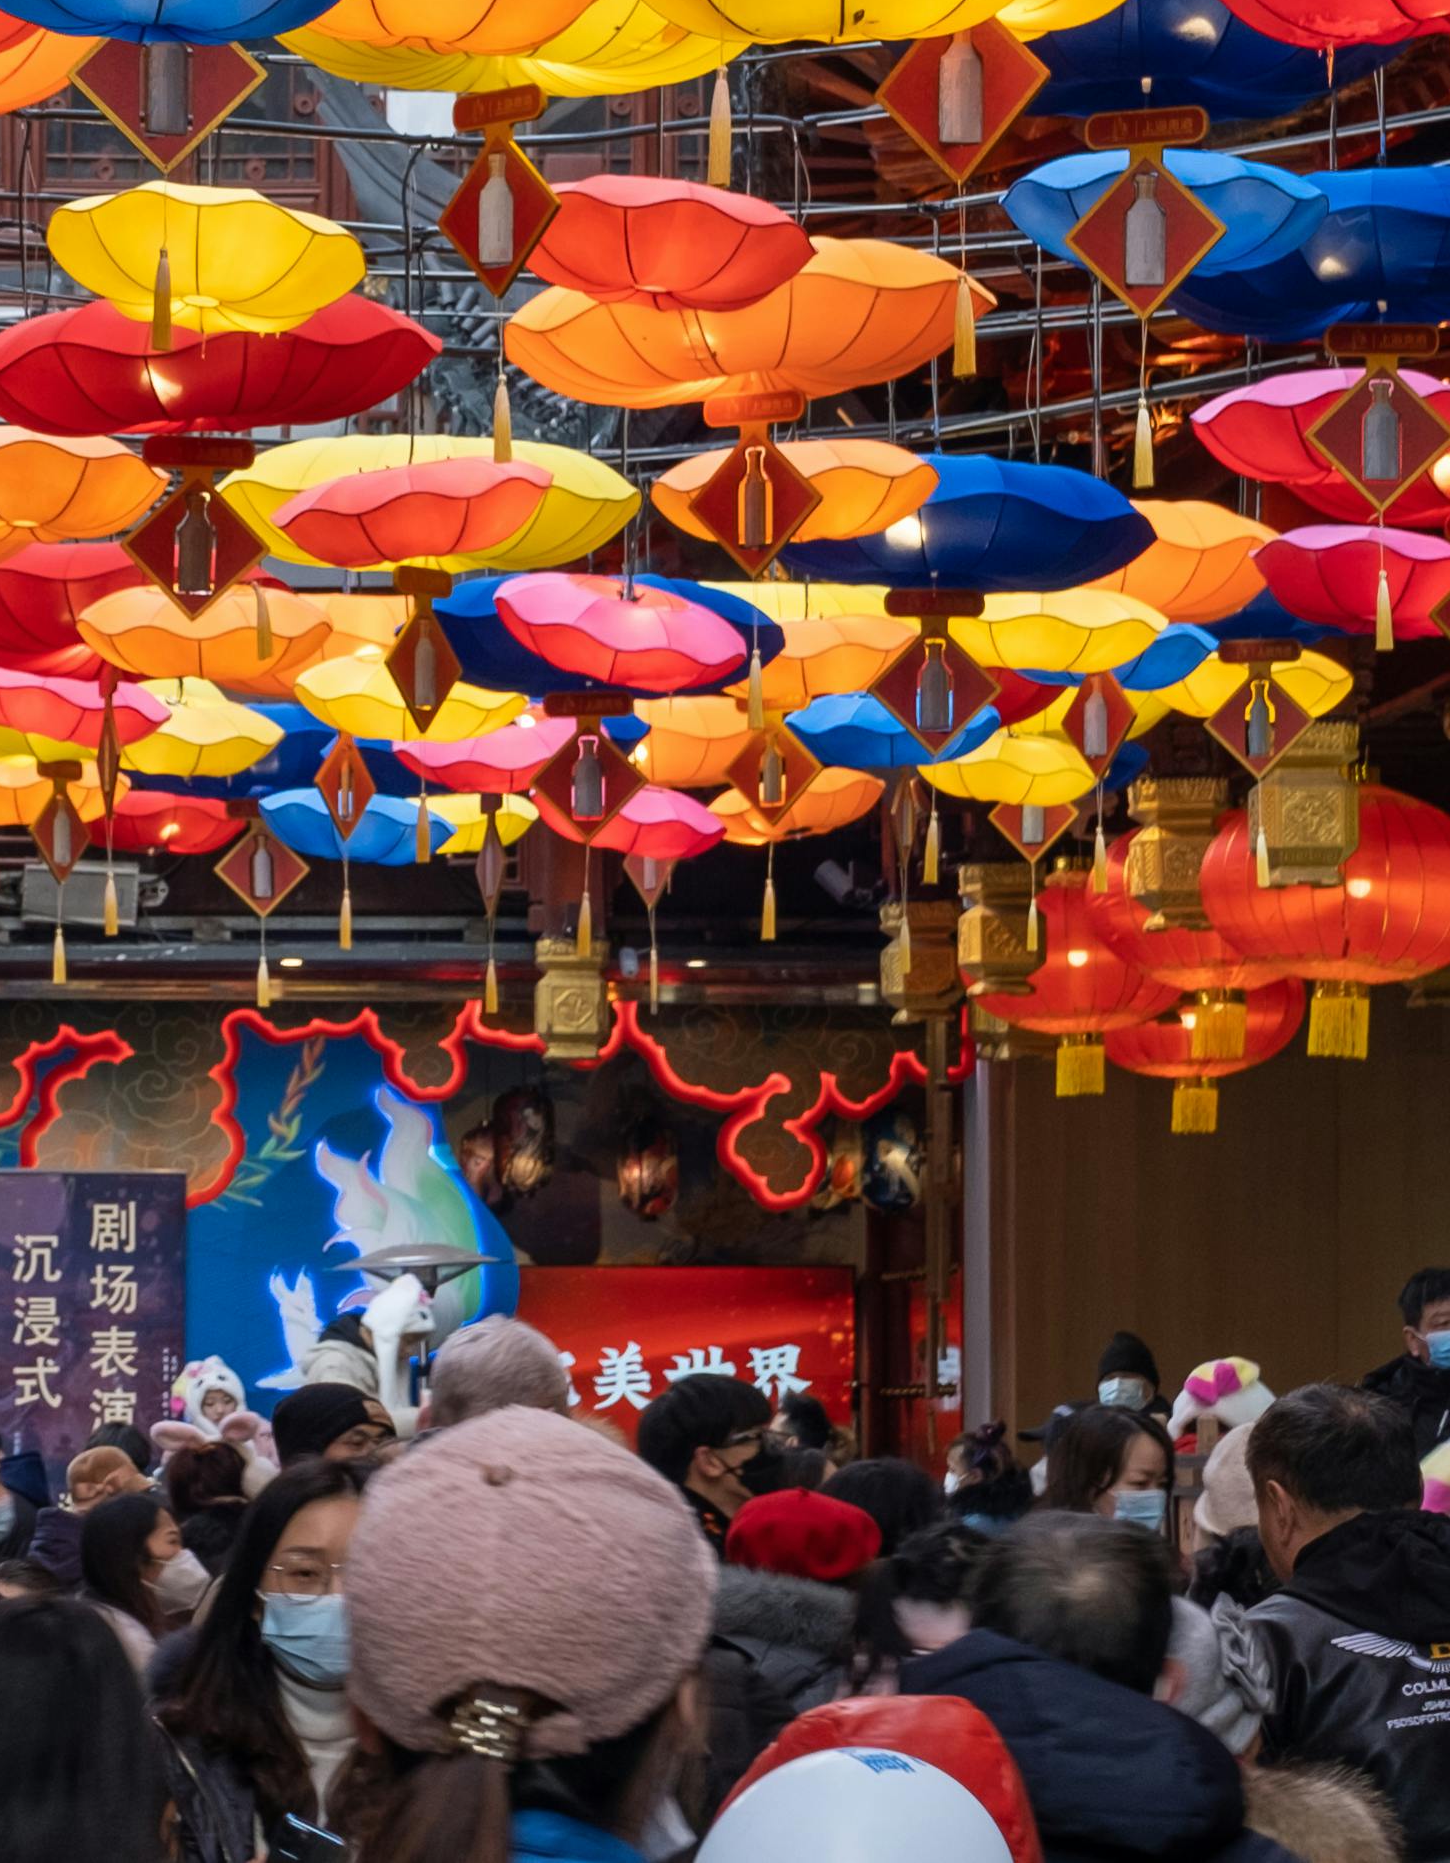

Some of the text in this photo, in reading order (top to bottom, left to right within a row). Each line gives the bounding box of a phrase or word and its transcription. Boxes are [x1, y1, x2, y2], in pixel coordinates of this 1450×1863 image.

[12, 1233, 63, 1409] 沉浸式
[89, 1201, 139, 1436] 剧场表演
